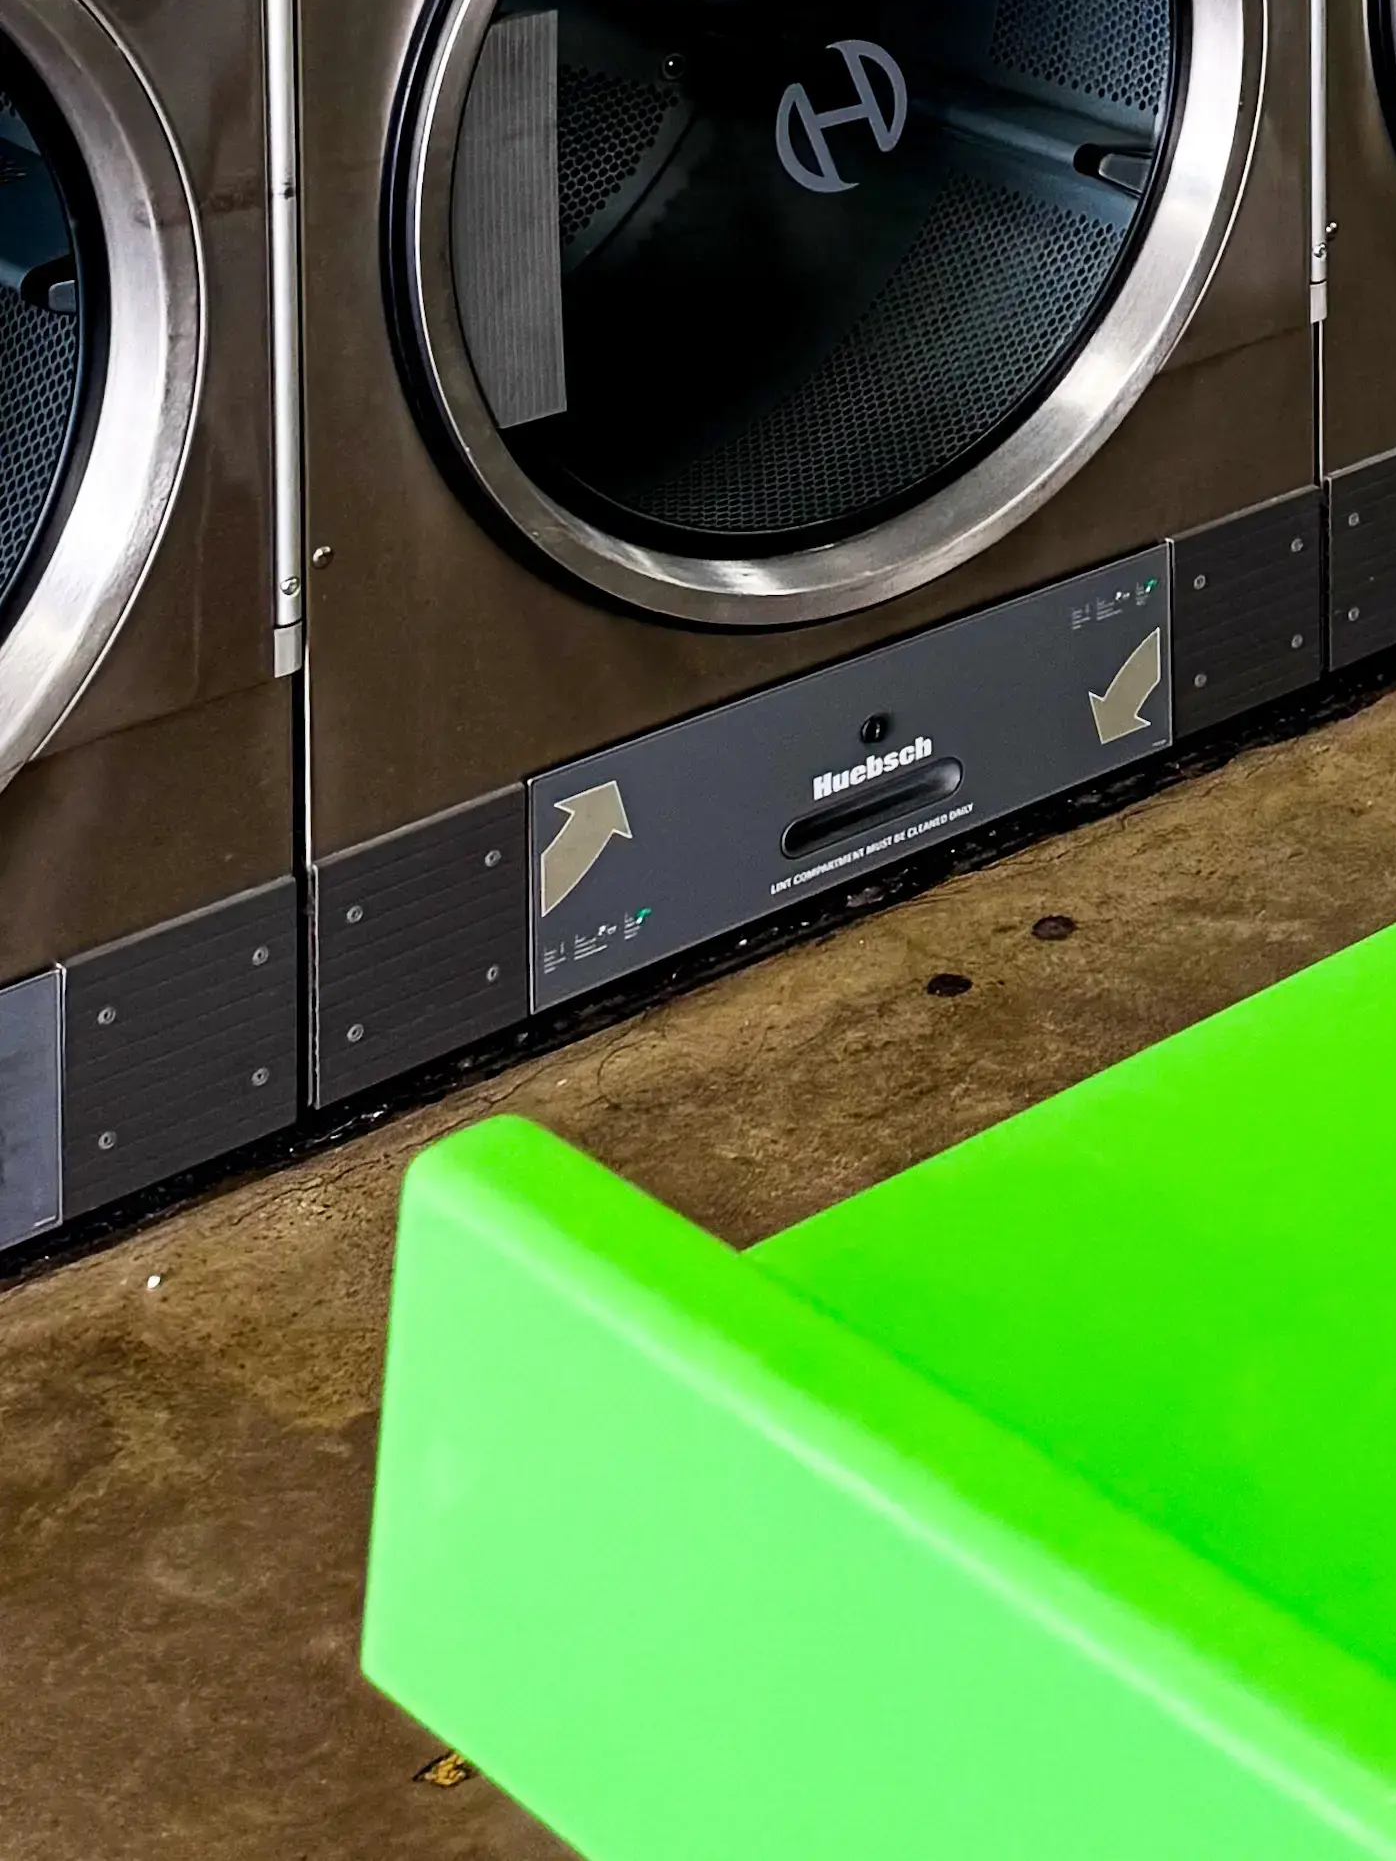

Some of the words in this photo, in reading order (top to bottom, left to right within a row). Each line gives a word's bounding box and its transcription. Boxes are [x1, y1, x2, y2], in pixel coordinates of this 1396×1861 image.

[813, 736, 932, 801] Huebsch
[770, 876, 792, 895] LINT
[793, 847, 865, 886] COMPARTMENT
[865, 836, 893, 855] MUST
[893, 830, 906, 844] BE
[907, 813, 948, 839] CLEANED
[949, 802, 974, 821] DAILY
